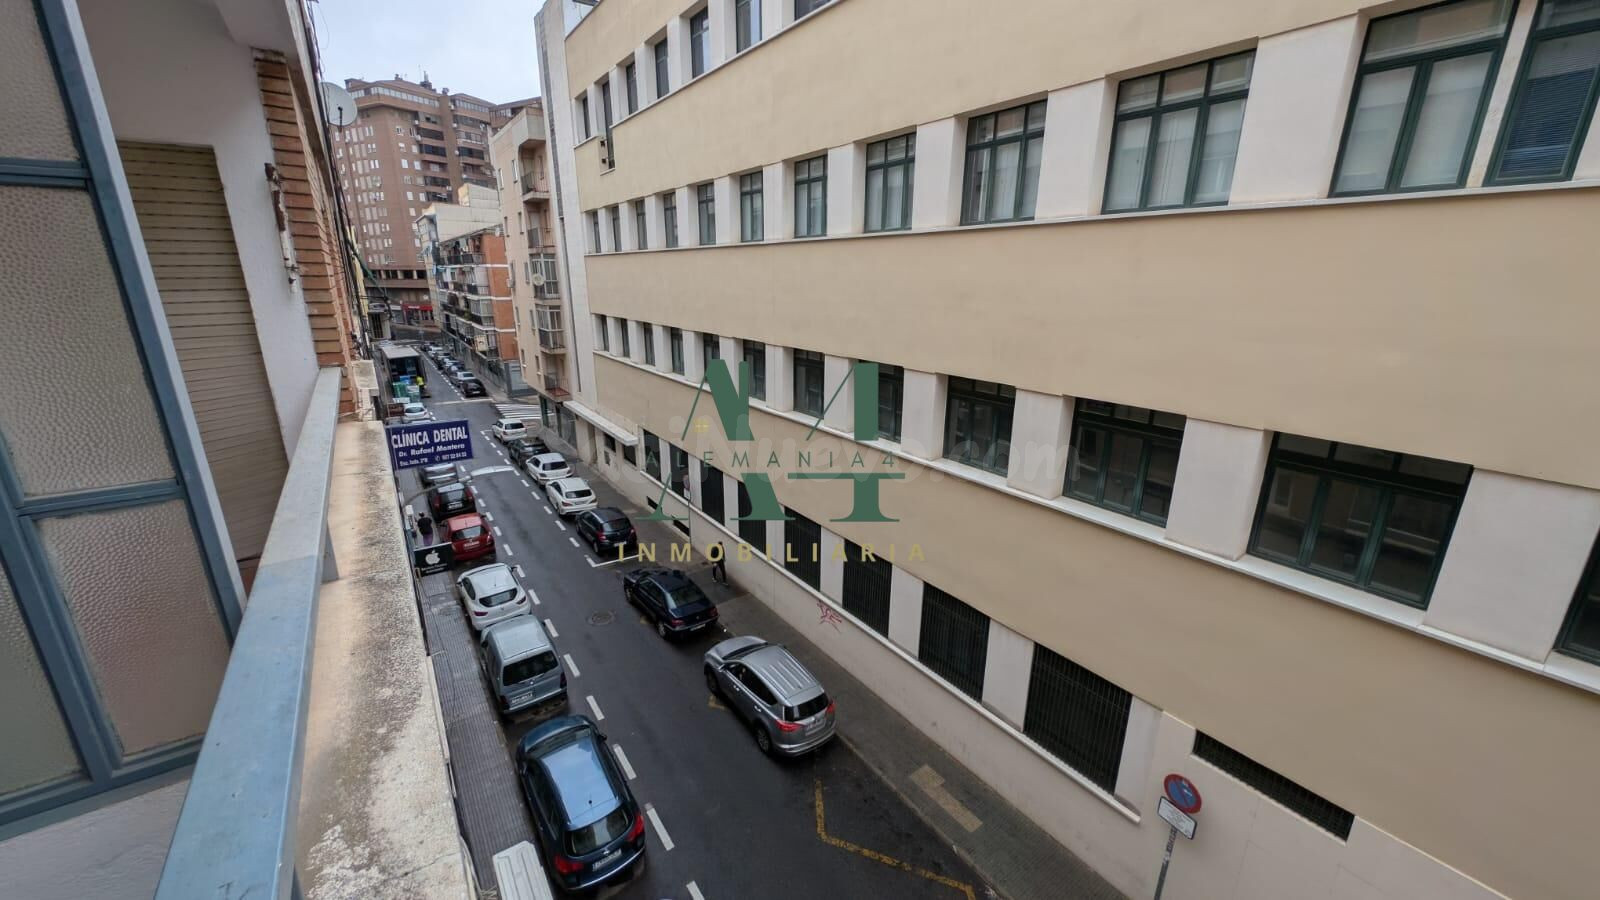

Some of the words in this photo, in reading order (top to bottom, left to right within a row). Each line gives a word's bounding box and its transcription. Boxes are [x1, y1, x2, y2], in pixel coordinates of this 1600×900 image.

[391, 429, 430, 448] CLÍNICA
[433, 426, 468, 443] DENTAL
[410, 446, 435, 456] Rafael
